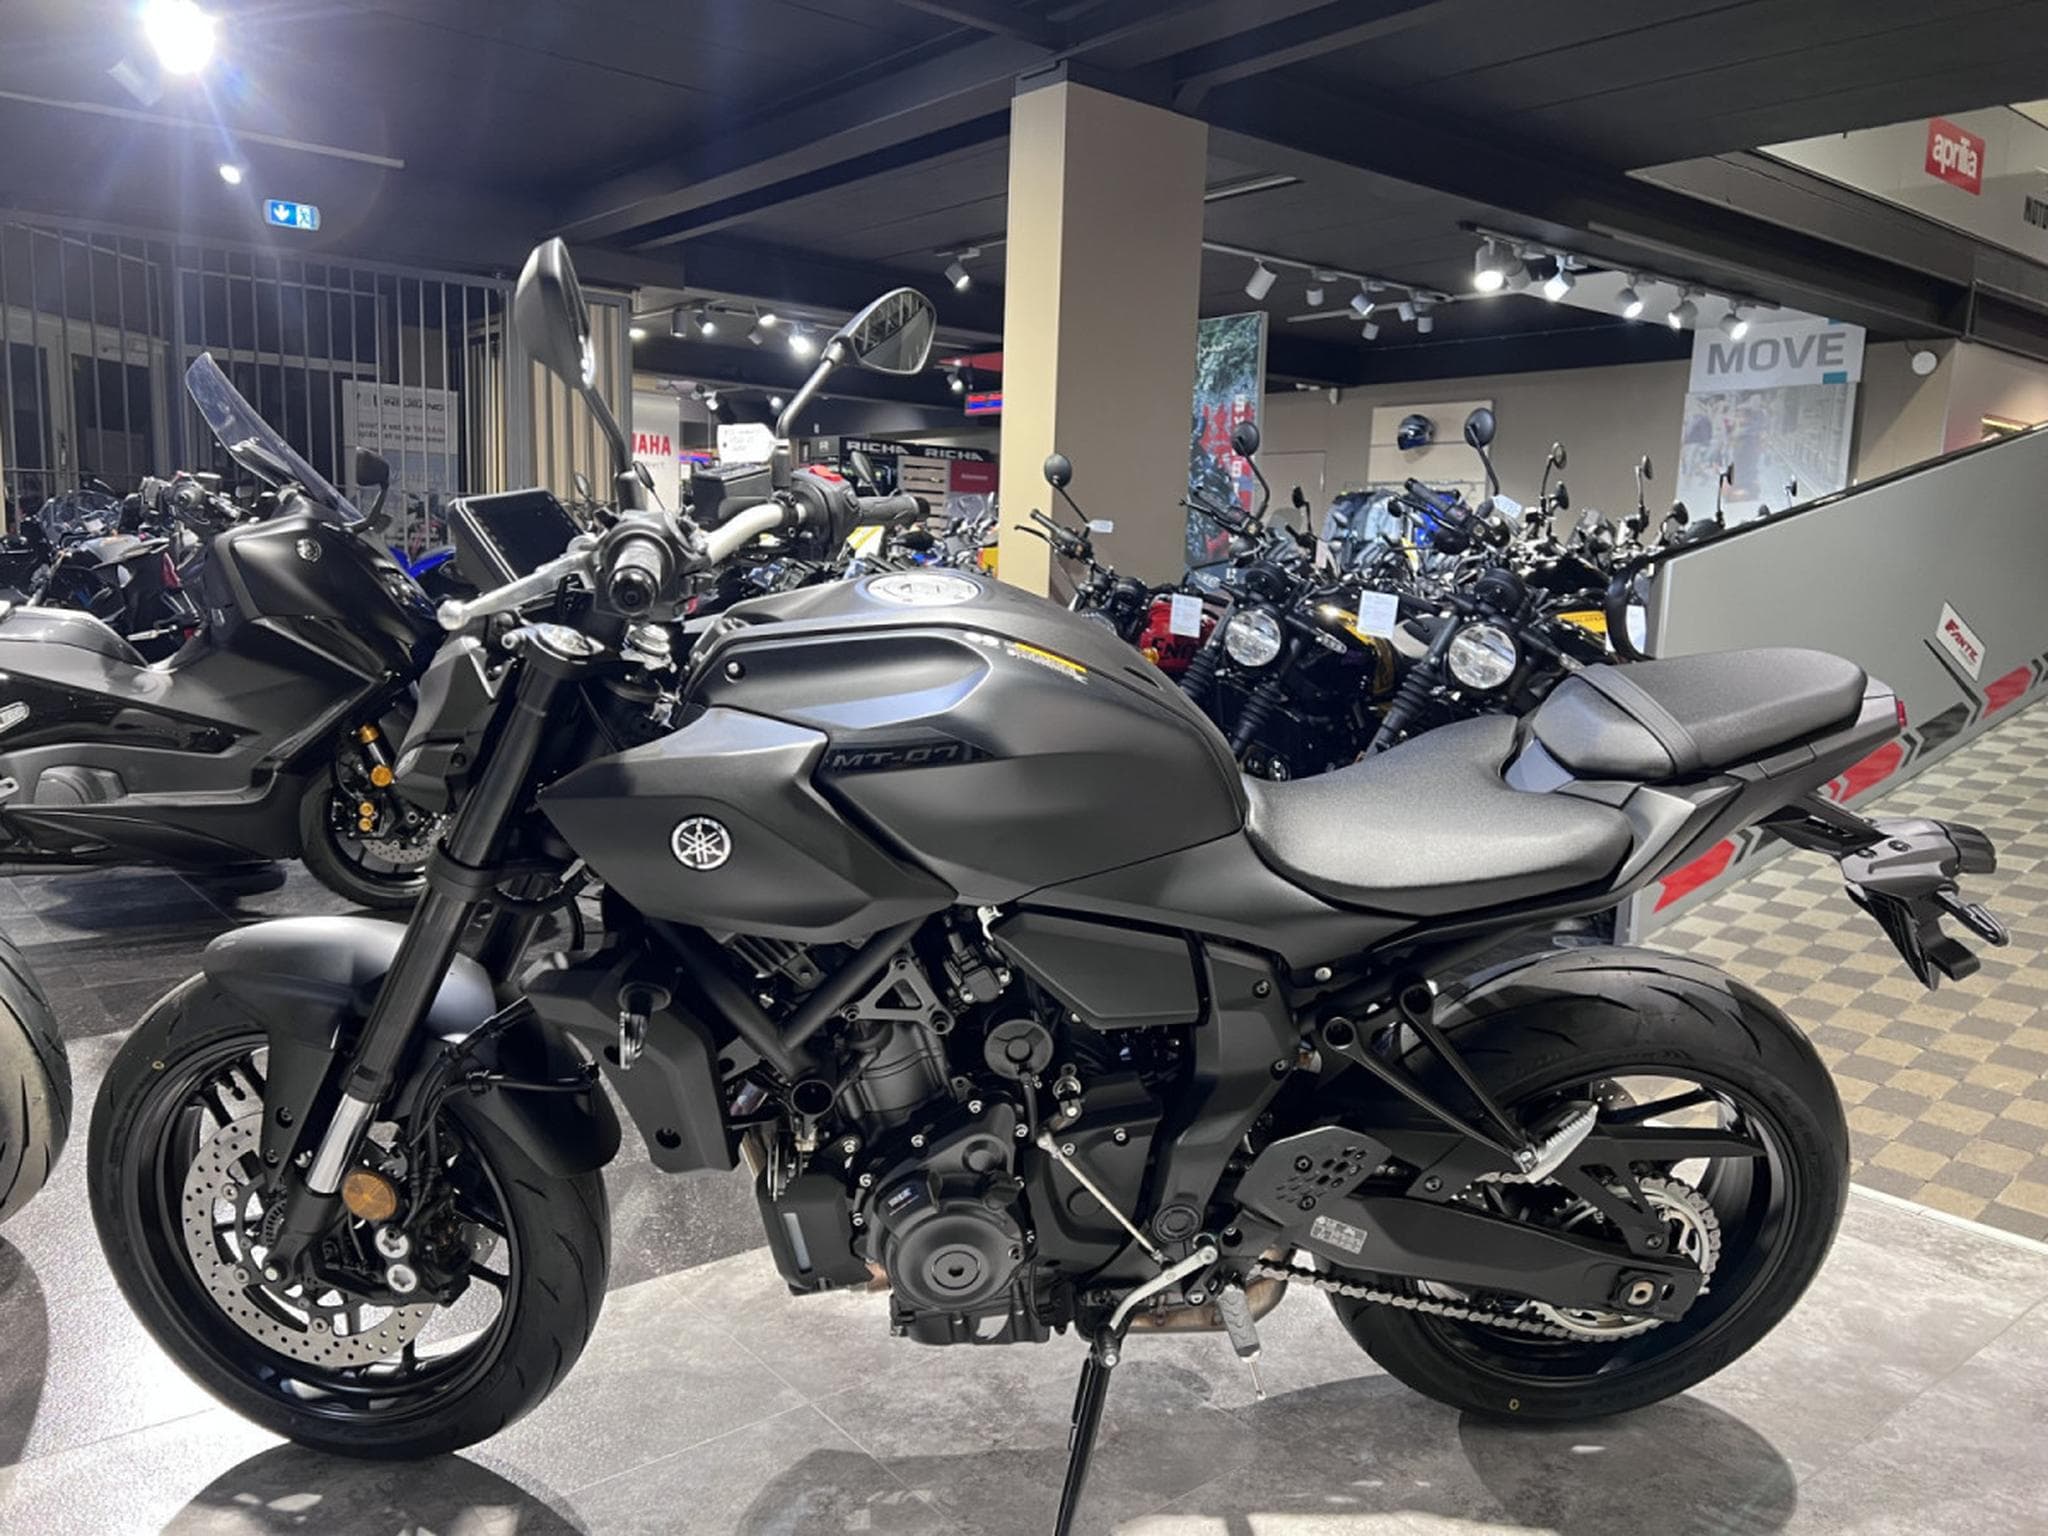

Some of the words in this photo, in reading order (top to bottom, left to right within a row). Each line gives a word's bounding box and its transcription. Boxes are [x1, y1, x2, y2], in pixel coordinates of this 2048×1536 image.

[1932, 134, 1978, 179] aprilia
[1707, 332, 1846, 375] MOVE
[846, 440, 910, 455] RICHA
[924, 448, 984, 462] RICHA
[832, 744, 959, 768] MT-07
